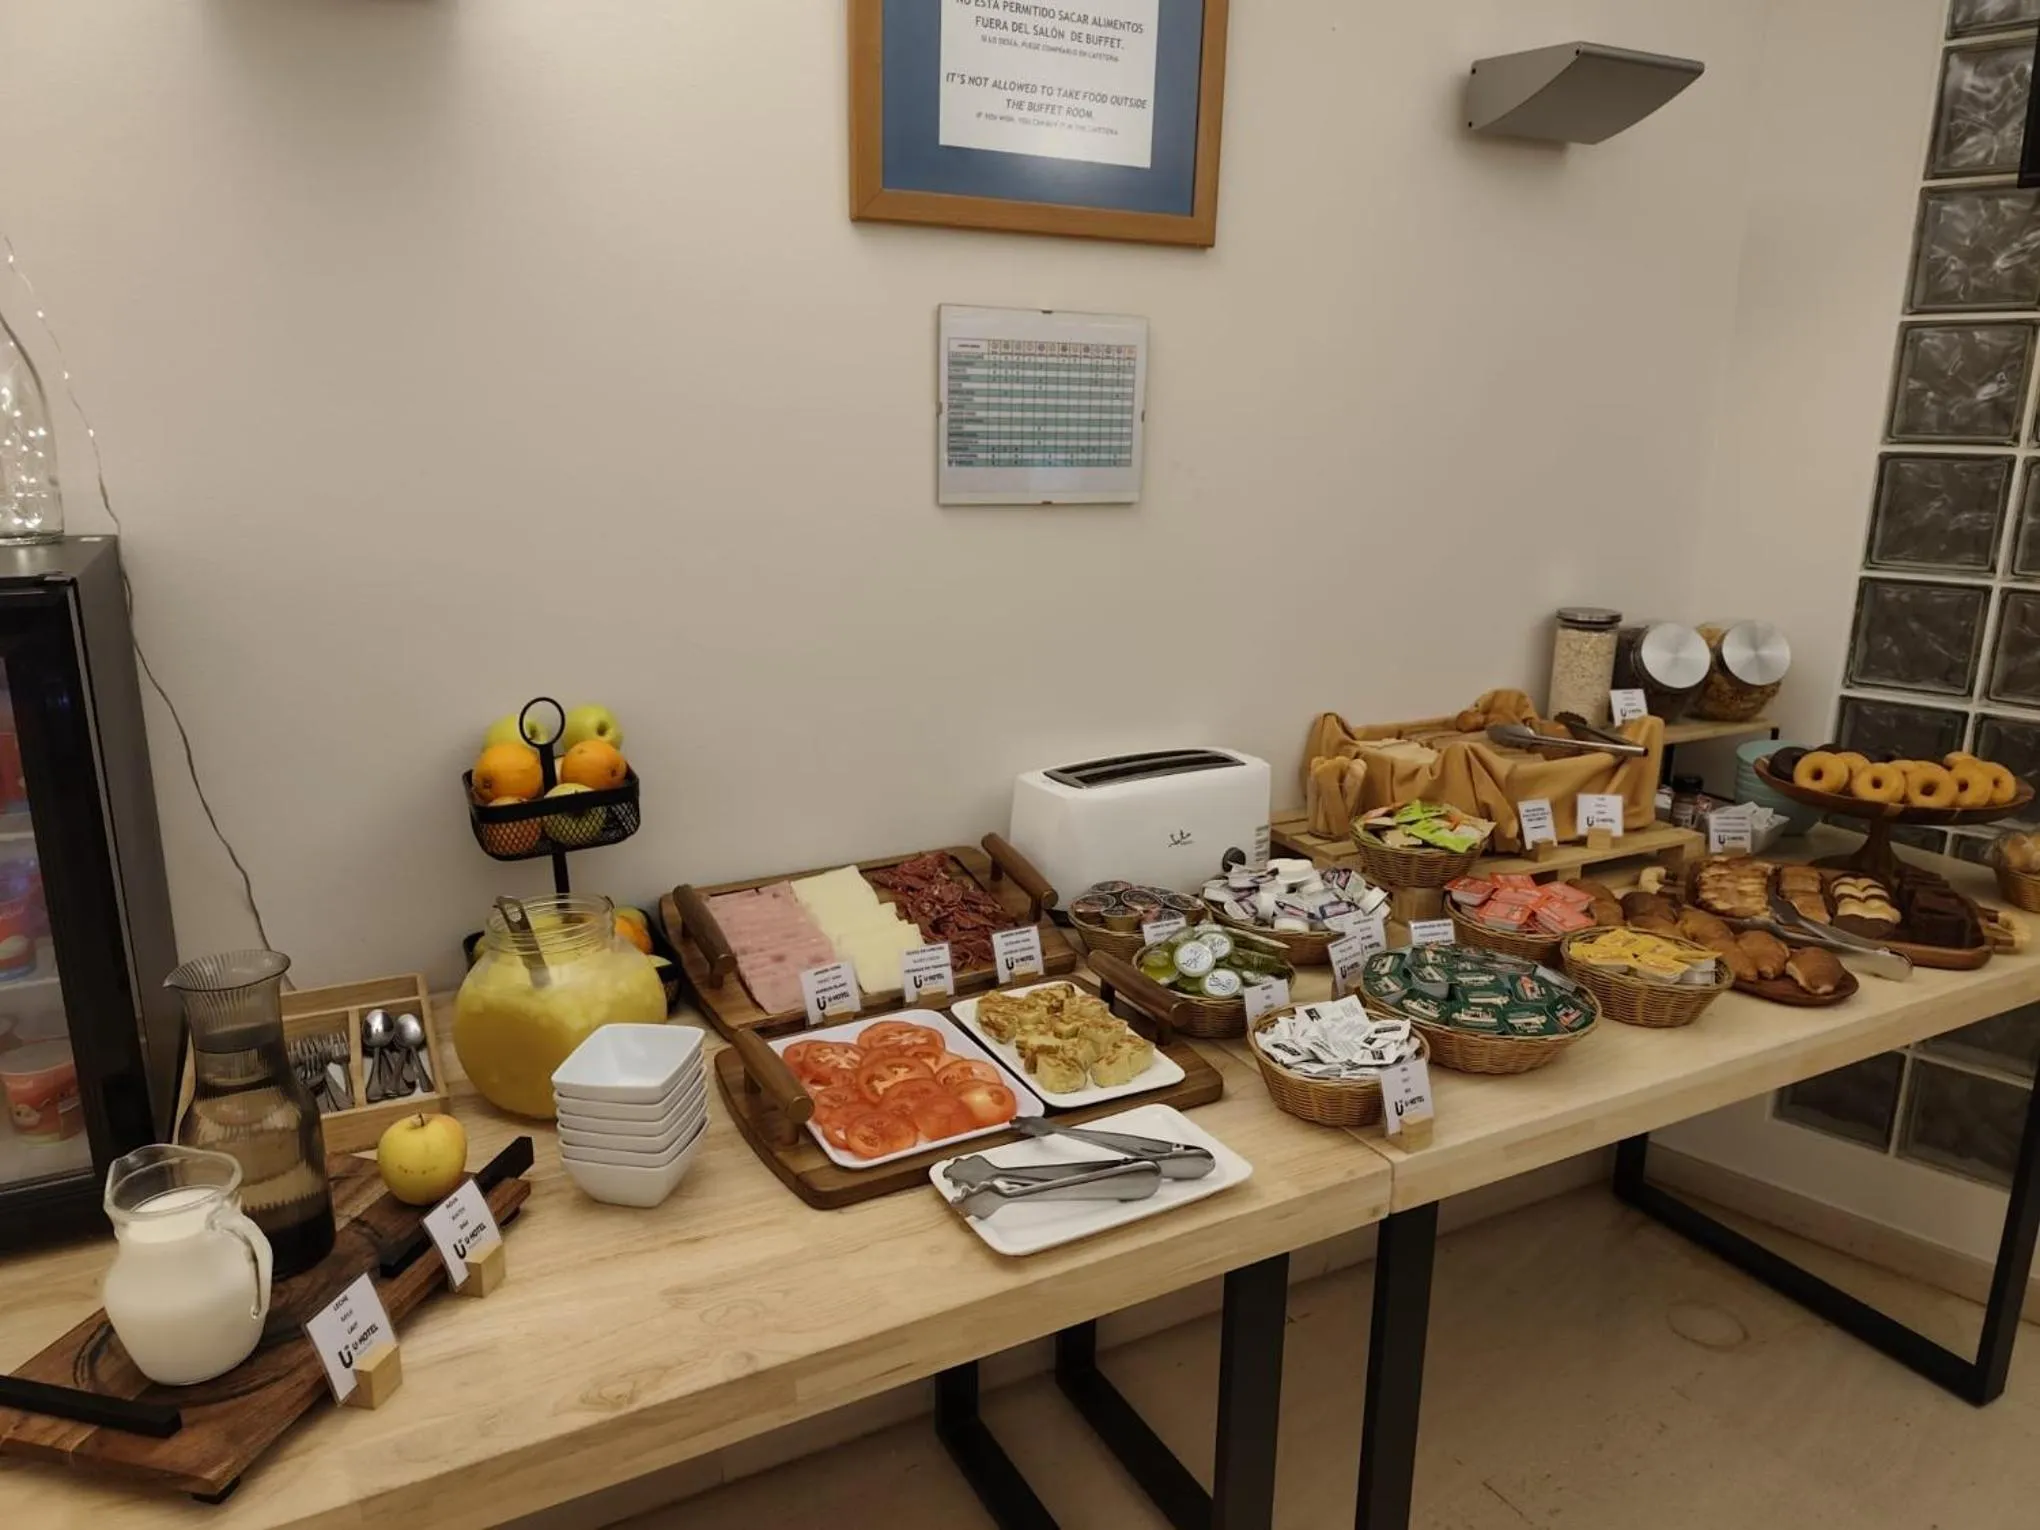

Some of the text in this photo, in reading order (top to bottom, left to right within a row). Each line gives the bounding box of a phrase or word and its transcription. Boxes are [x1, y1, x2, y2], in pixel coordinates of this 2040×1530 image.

[975, 16, 1008, 32] FUERA
[1011, 22, 1031, 35] DEL
[1071, 31, 1084, 43] DE
[1003, 1, 1056, 19] PERMITIDO
[1058, 10, 1089, 25] SACAR
[1091, 16, 1144, 34] ALIMENTOS
[946, 72, 1148, 109] IT'S NOT ALLOWED TO TAKE FOOD OUTSIDE
[1006, 98, 1024, 111] THE
[1027, 101, 1063, 116] BUFFET
[358, 1323, 379, 1344] HOTEL
